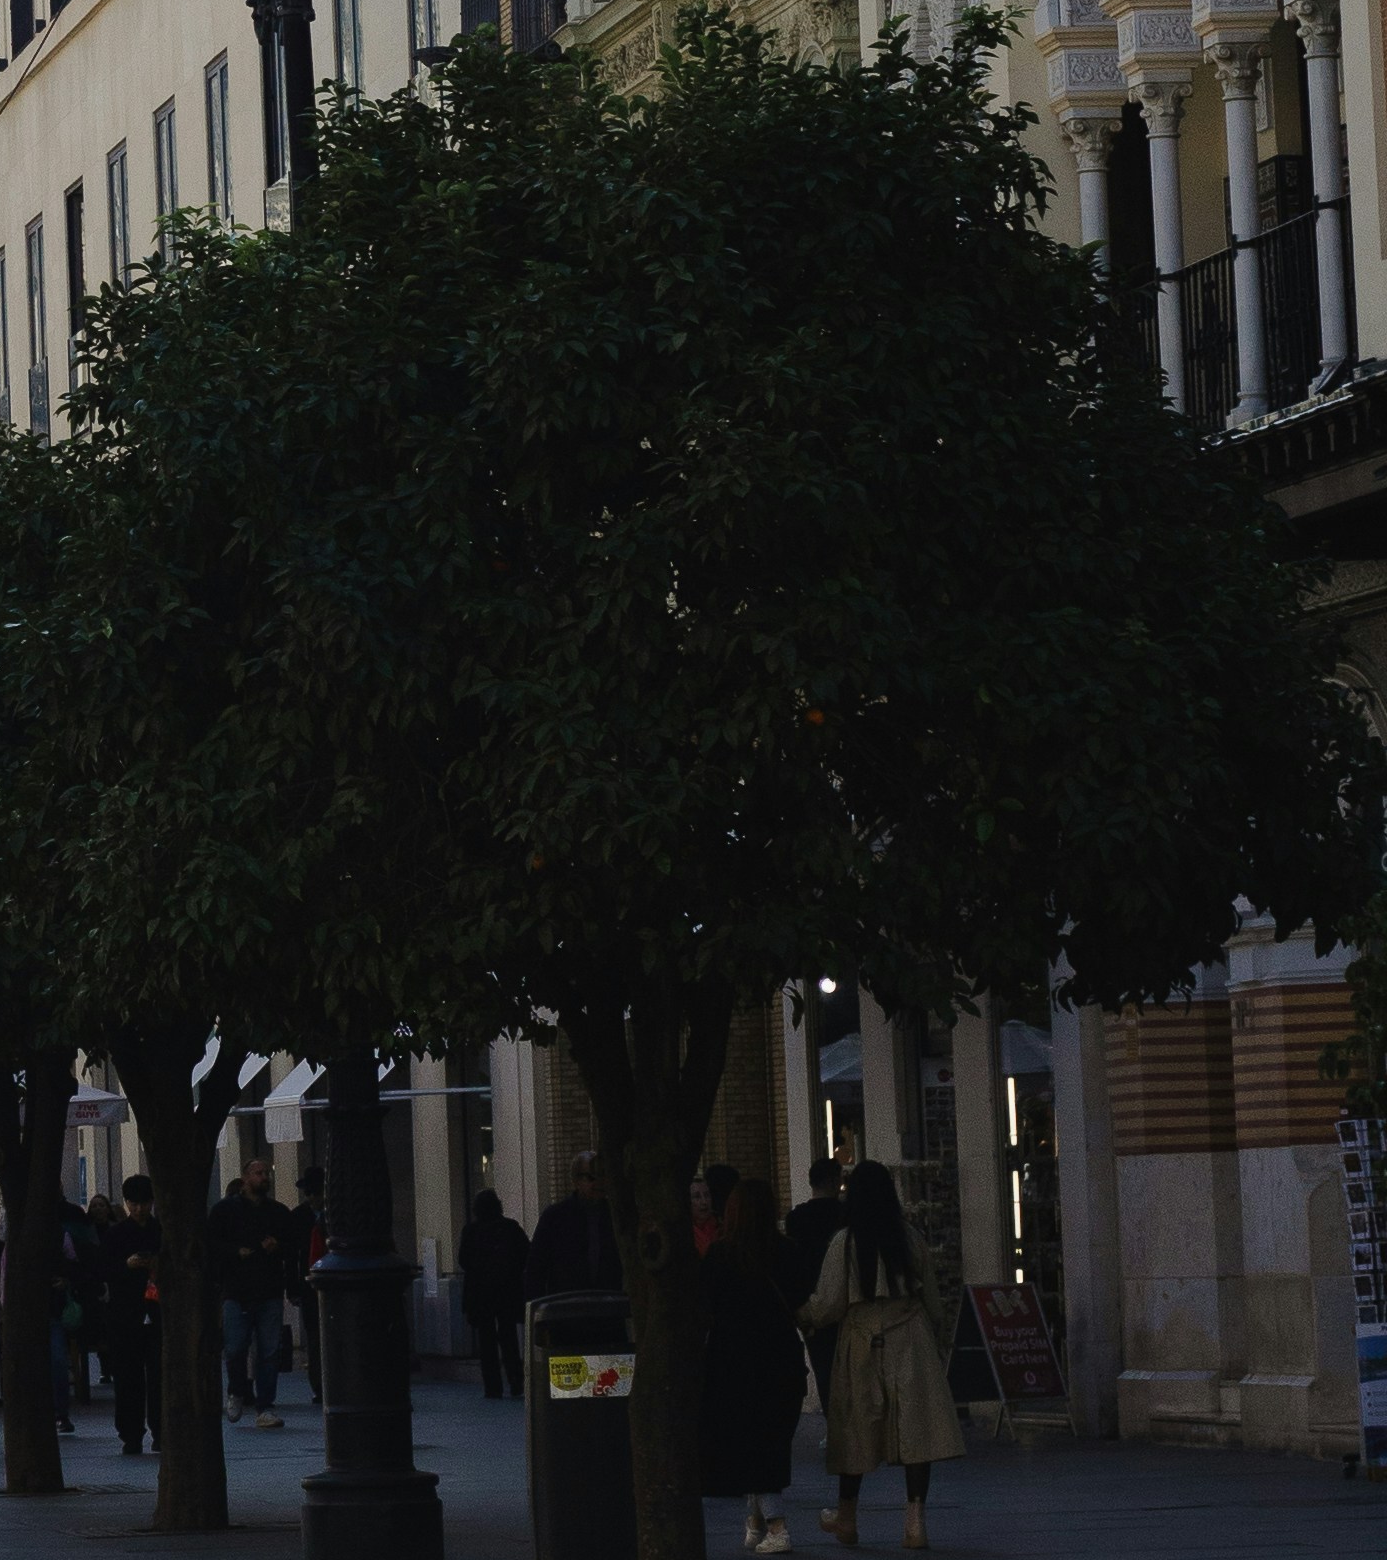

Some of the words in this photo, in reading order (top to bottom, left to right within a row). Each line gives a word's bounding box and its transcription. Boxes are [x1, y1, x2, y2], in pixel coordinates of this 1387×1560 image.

[993, 1326, 1013, 1338] Buy
[1015, 1327, 1037, 1338] your
[991, 1340, 1028, 1352] Prepaid
[1030, 1339, 1048, 1350] SIM
[1001, 1354, 1024, 1365] Card
[1026, 1353, 1048, 1364] here
